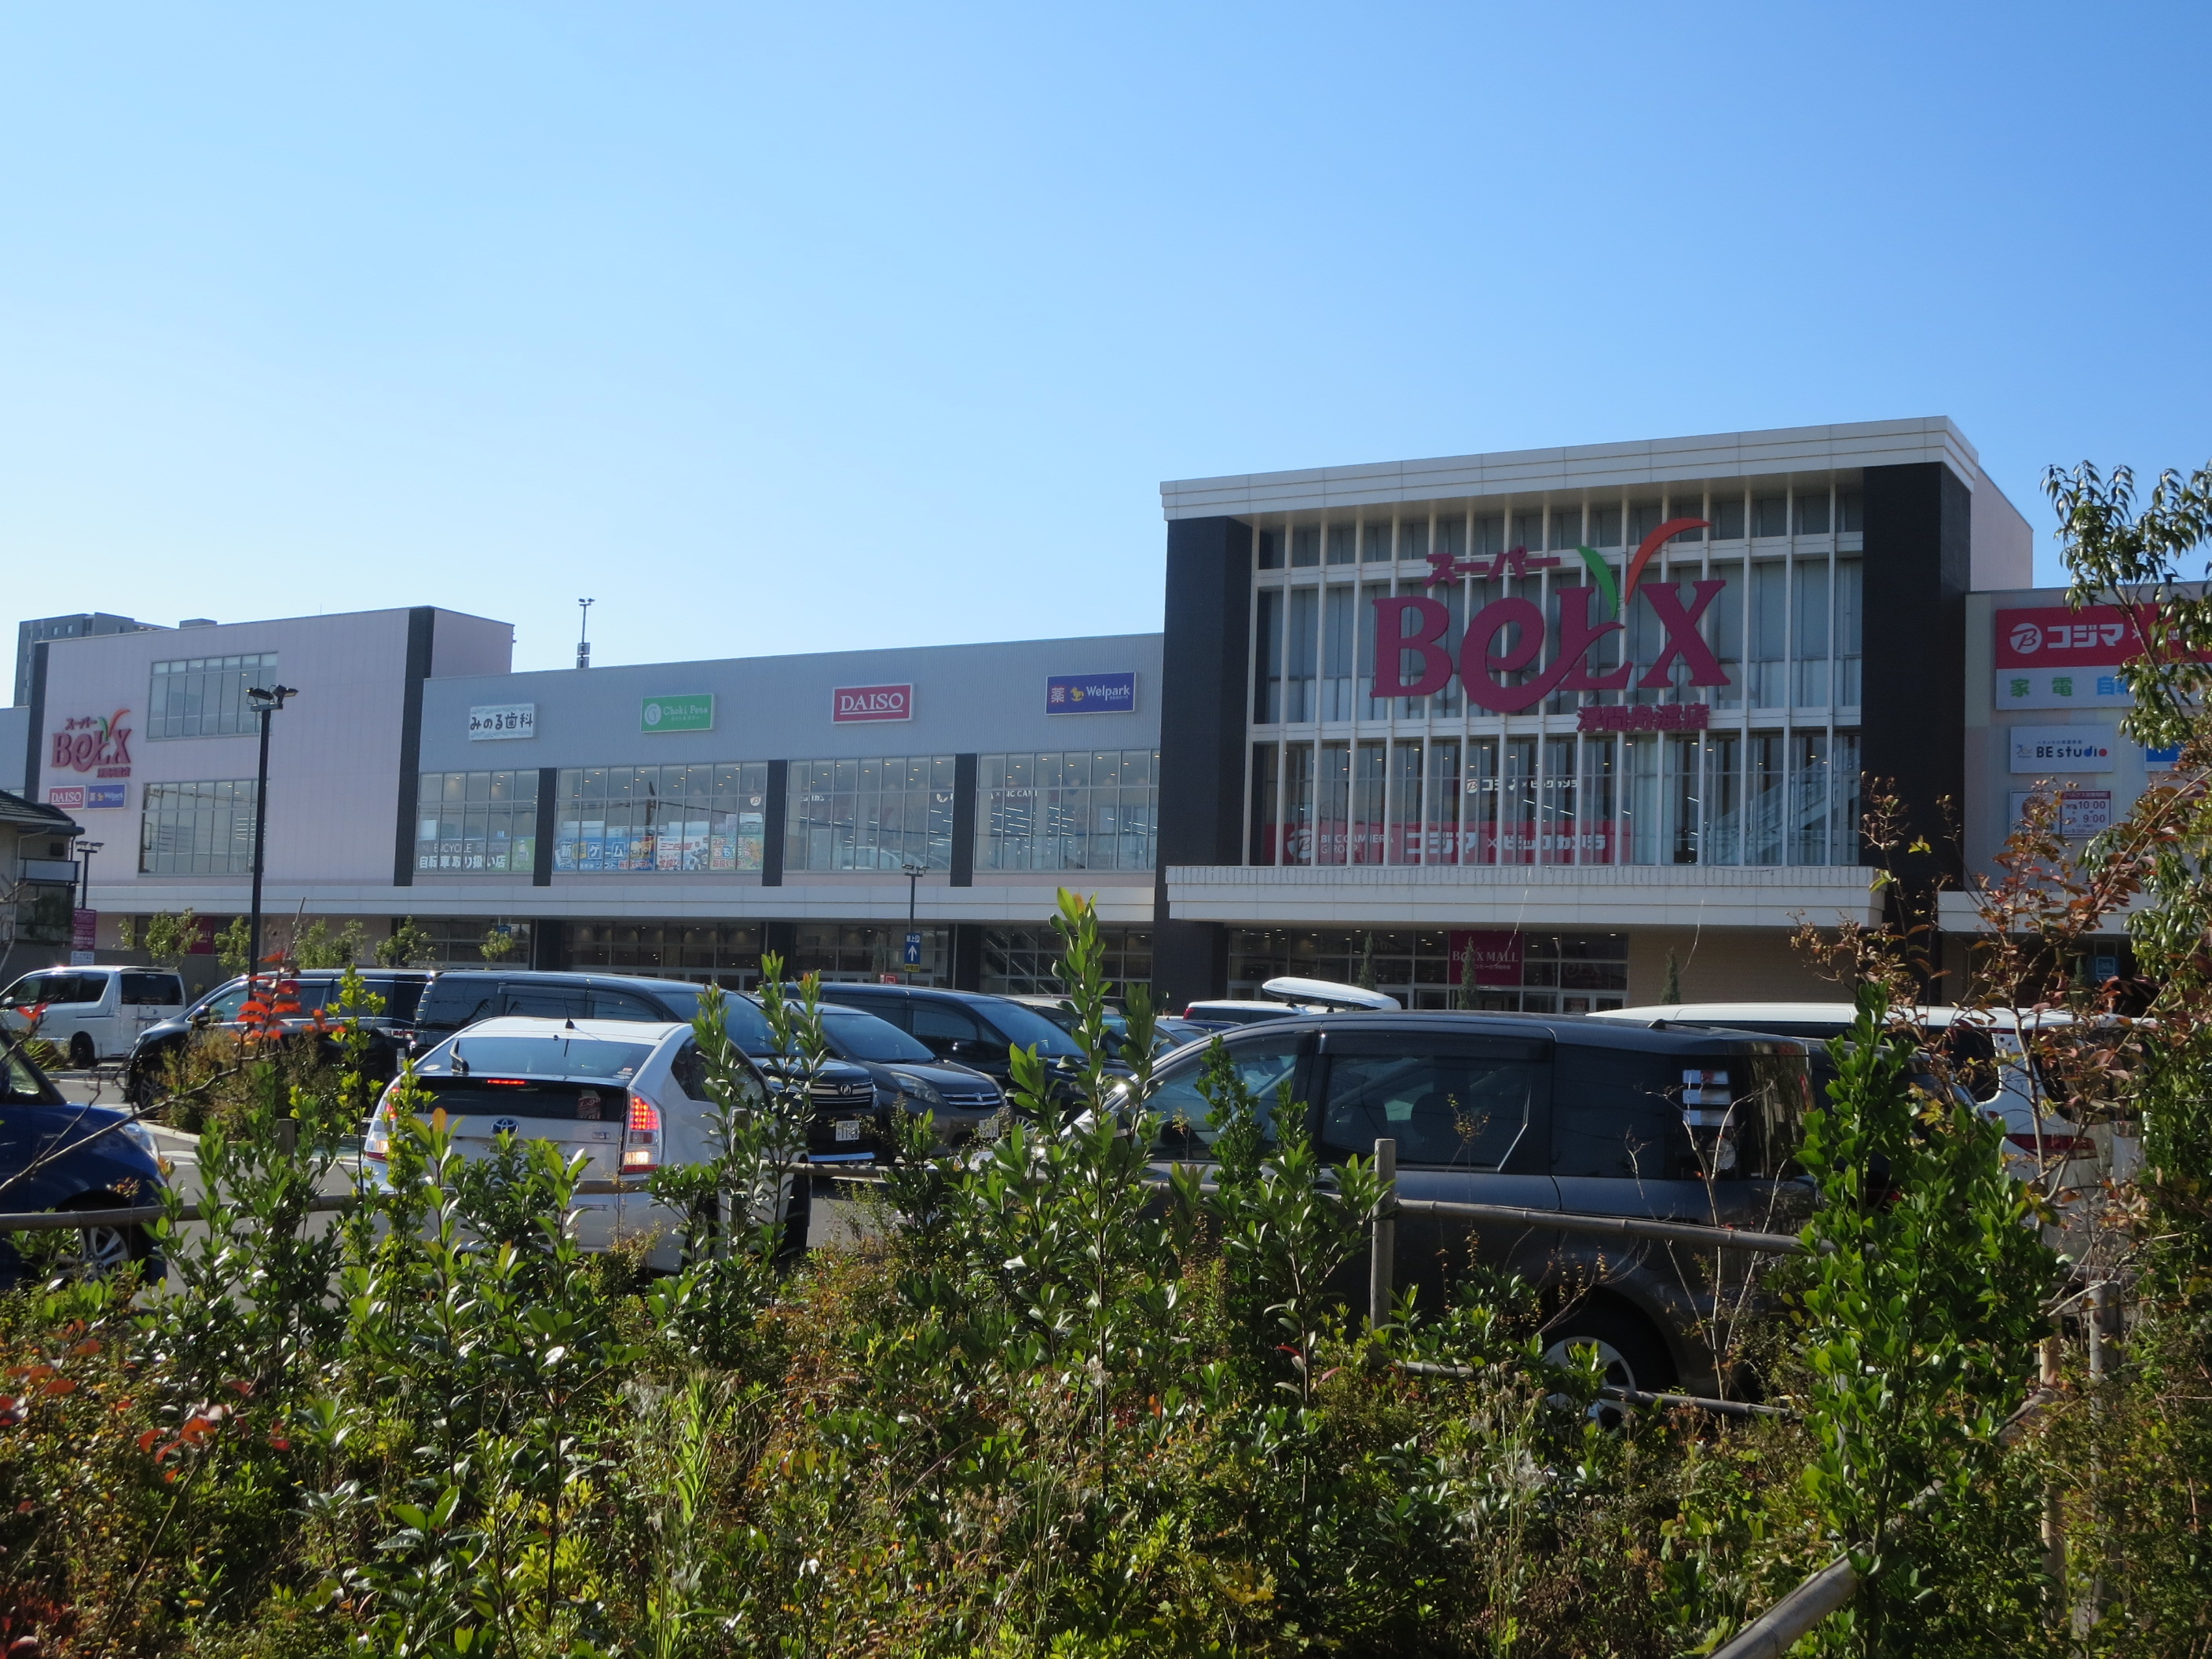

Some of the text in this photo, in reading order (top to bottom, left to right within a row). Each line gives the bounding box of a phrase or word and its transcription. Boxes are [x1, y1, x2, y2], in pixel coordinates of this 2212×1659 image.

[1423, 546, 1561, 588] スーパー
[1051, 687, 1065, 703] 薬
[1086, 684, 1130, 701] Welpark
[840, 692, 903, 712] DAISO
[469, 712, 533, 731] みのる歯科
[2036, 745, 2108, 758] BE studio
[51, 792, 82, 803] DAISO
[2078, 800, 2106, 809] 10:00
[2082, 814, 2106, 823] 9:00
[1486, 951, 1519, 962] MALL
